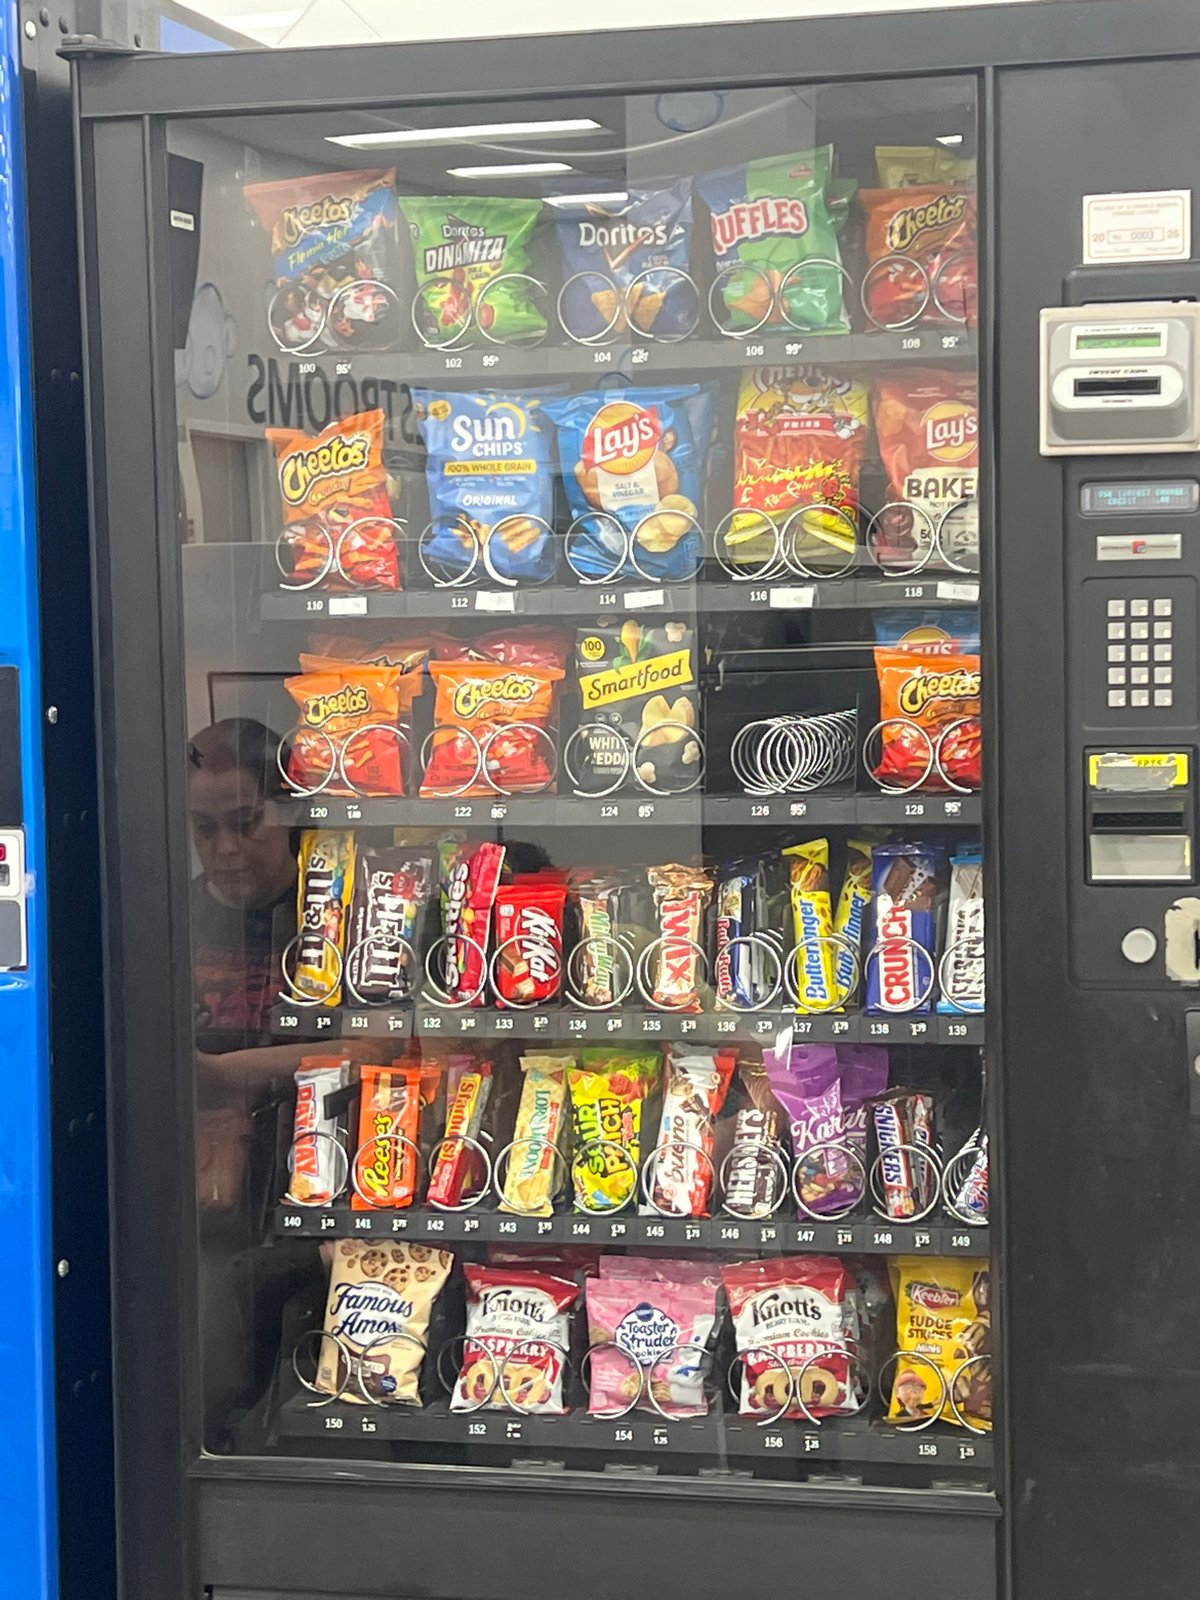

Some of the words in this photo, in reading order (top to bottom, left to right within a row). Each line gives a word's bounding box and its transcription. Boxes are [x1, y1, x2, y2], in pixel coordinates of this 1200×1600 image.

[889, 195, 966, 250] Cheetos
[443, 224, 485, 238] Doritos
[578, 222, 668, 247] Doritos
[425, 237, 504, 273] DINAMITA
[902, 337, 920, 349] 108
[745, 346, 765, 356] 106
[299, 364, 316, 373] 100
[445, 358, 463, 368] 102
[783, 420, 820, 429] FRIES
[450, 414, 516, 453] Sun
[926, 412, 978, 450] Lay's
[593, 412, 655, 466] Lay's
[472, 441, 524, 457] CHIPS
[281, 435, 368, 503] Cheetos
[447, 463, 470, 474] 100%
[471, 462, 503, 473] WHOLE
[504, 460, 532, 472] GRAIN
[615, 481, 632, 490] SALT
[905, 476, 975, 500] BAKE
[611, 487, 645, 498] VINEGAR
[462, 494, 518, 507] ORIGINAL
[750, 591, 767, 600] 116
[904, 587, 923, 597] 118
[451, 598, 468, 607] 112
[599, 594, 616, 604] 114
[307, 601, 323, 610] 110
[583, 640, 602, 651] 100
[588, 658, 686, 701] Smartfood
[454, 672, 536, 717] Cheetos
[900, 669, 981, 713] Cheetos
[305, 685, 369, 725] Cheetos
[310, 807, 328, 818] 120
[454, 806, 472, 817] 122
[601, 806, 619, 817] 124
[751, 805, 770, 816] 126
[905, 805, 924, 815] 128
[799, 898, 829, 1001] Butterfinger
[882, 903, 912, 1006] CRUNCH
[718, 955, 734, 997] Ruth
[280, 1017, 298, 1026] 130
[351, 1017, 369, 1027] 131
[423, 1018, 441, 1027] 132
[495, 1019, 513, 1029] 133
[569, 1020, 587, 1030] 134
[643, 1020, 661, 1030] 135
[718, 1022, 736, 1032] 136
[794, 1023, 812, 1033] 137
[870, 1024, 889, 1034] 138
[949, 1026, 967, 1036] 139
[438, 1079, 476, 1161] Starbust
[663, 1114, 685, 1184] bueno
[874, 1104, 903, 1186] SNICKERS
[362, 1112, 394, 1198] Reese's
[727, 1107, 764, 1207] HERSHEY'S
[284, 1217, 302, 1226] 140
[355, 1219, 371, 1228] 141
[427, 1220, 444, 1230] 142
[499, 1222, 517, 1232] 143
[572, 1224, 590, 1234] 144
[646, 1226, 664, 1237] 145
[721, 1228, 739, 1239] 146
[797, 1231, 814, 1241] 147
[874, 1233, 892, 1244] 148
[952, 1236, 970, 1246] 149
[330, 1282, 414, 1318] Famous
[911, 1284, 958, 1308] Keebler
[751, 1293, 822, 1328] Knott's
[332, 1311, 402, 1336] Amos
[626, 1321, 670, 1336] Toaster
[909, 1315, 953, 1331] FUDGE
[325, 1417, 343, 1429] 150
[469, 1424, 486, 1434] 152
[615, 1430, 633, 1440] 154
[765, 1437, 783, 1447] 156
[918, 1445, 937, 1455] 158
